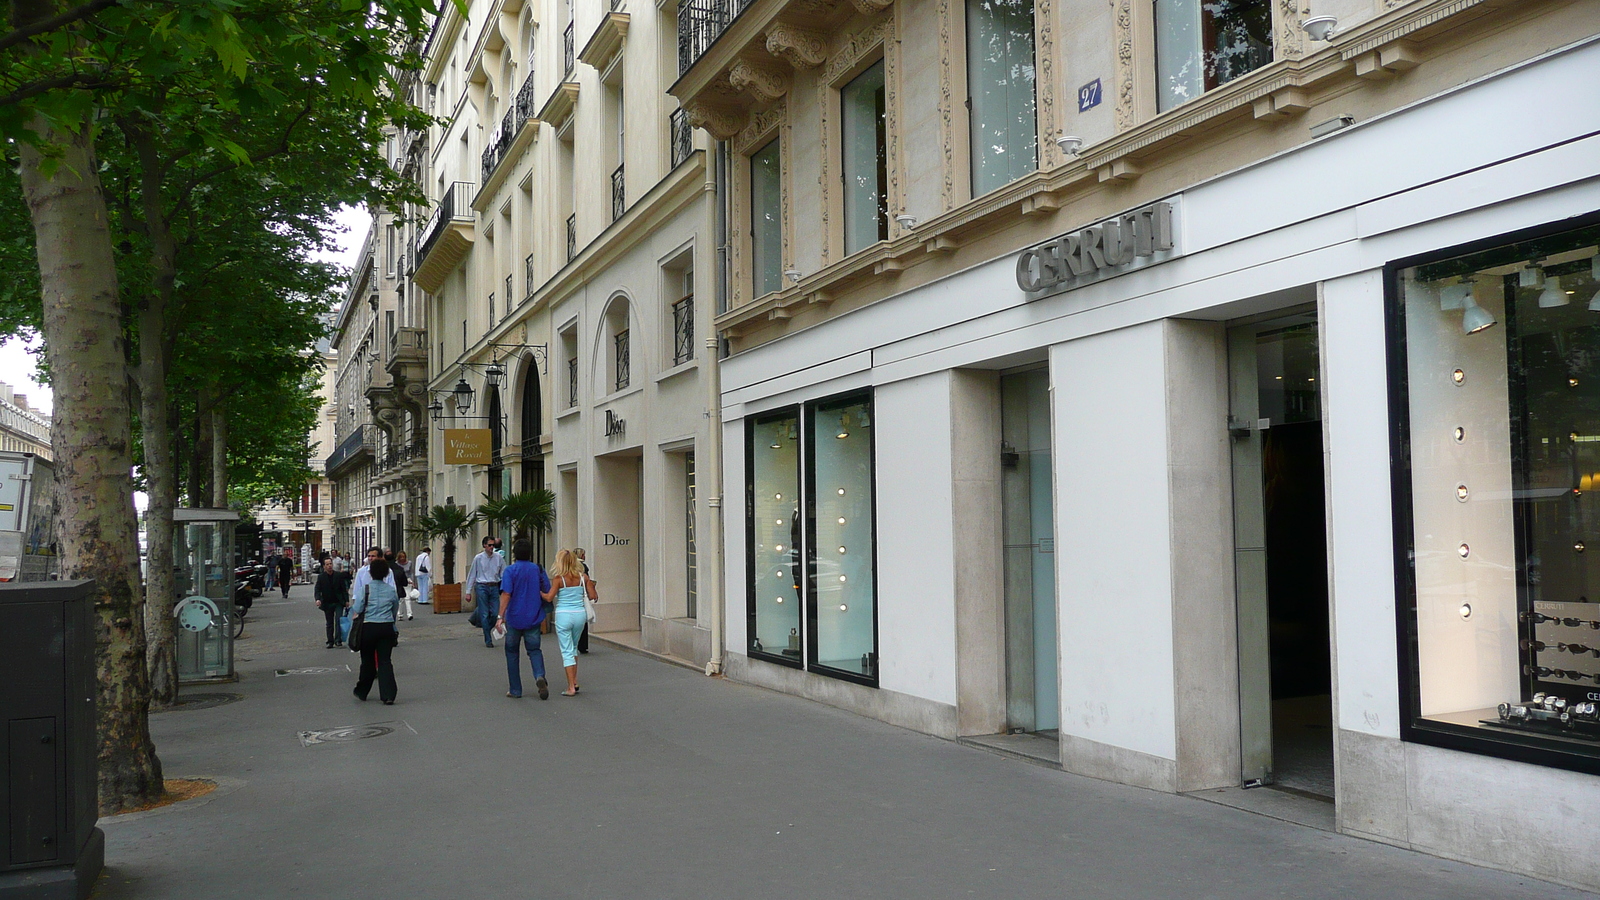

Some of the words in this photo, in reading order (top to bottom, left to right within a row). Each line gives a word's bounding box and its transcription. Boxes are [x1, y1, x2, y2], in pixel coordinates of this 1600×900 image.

[1081, 82, 1098, 109] 27
[1015, 201, 1172, 293] CERRUTI
[604, 409, 626, 437] Dior
[450, 439, 479, 450] Village
[603, 533, 631, 546] Dior
[1535, 603, 1565, 611] CERRUTI
[1586, 691, 1600, 702] CE
